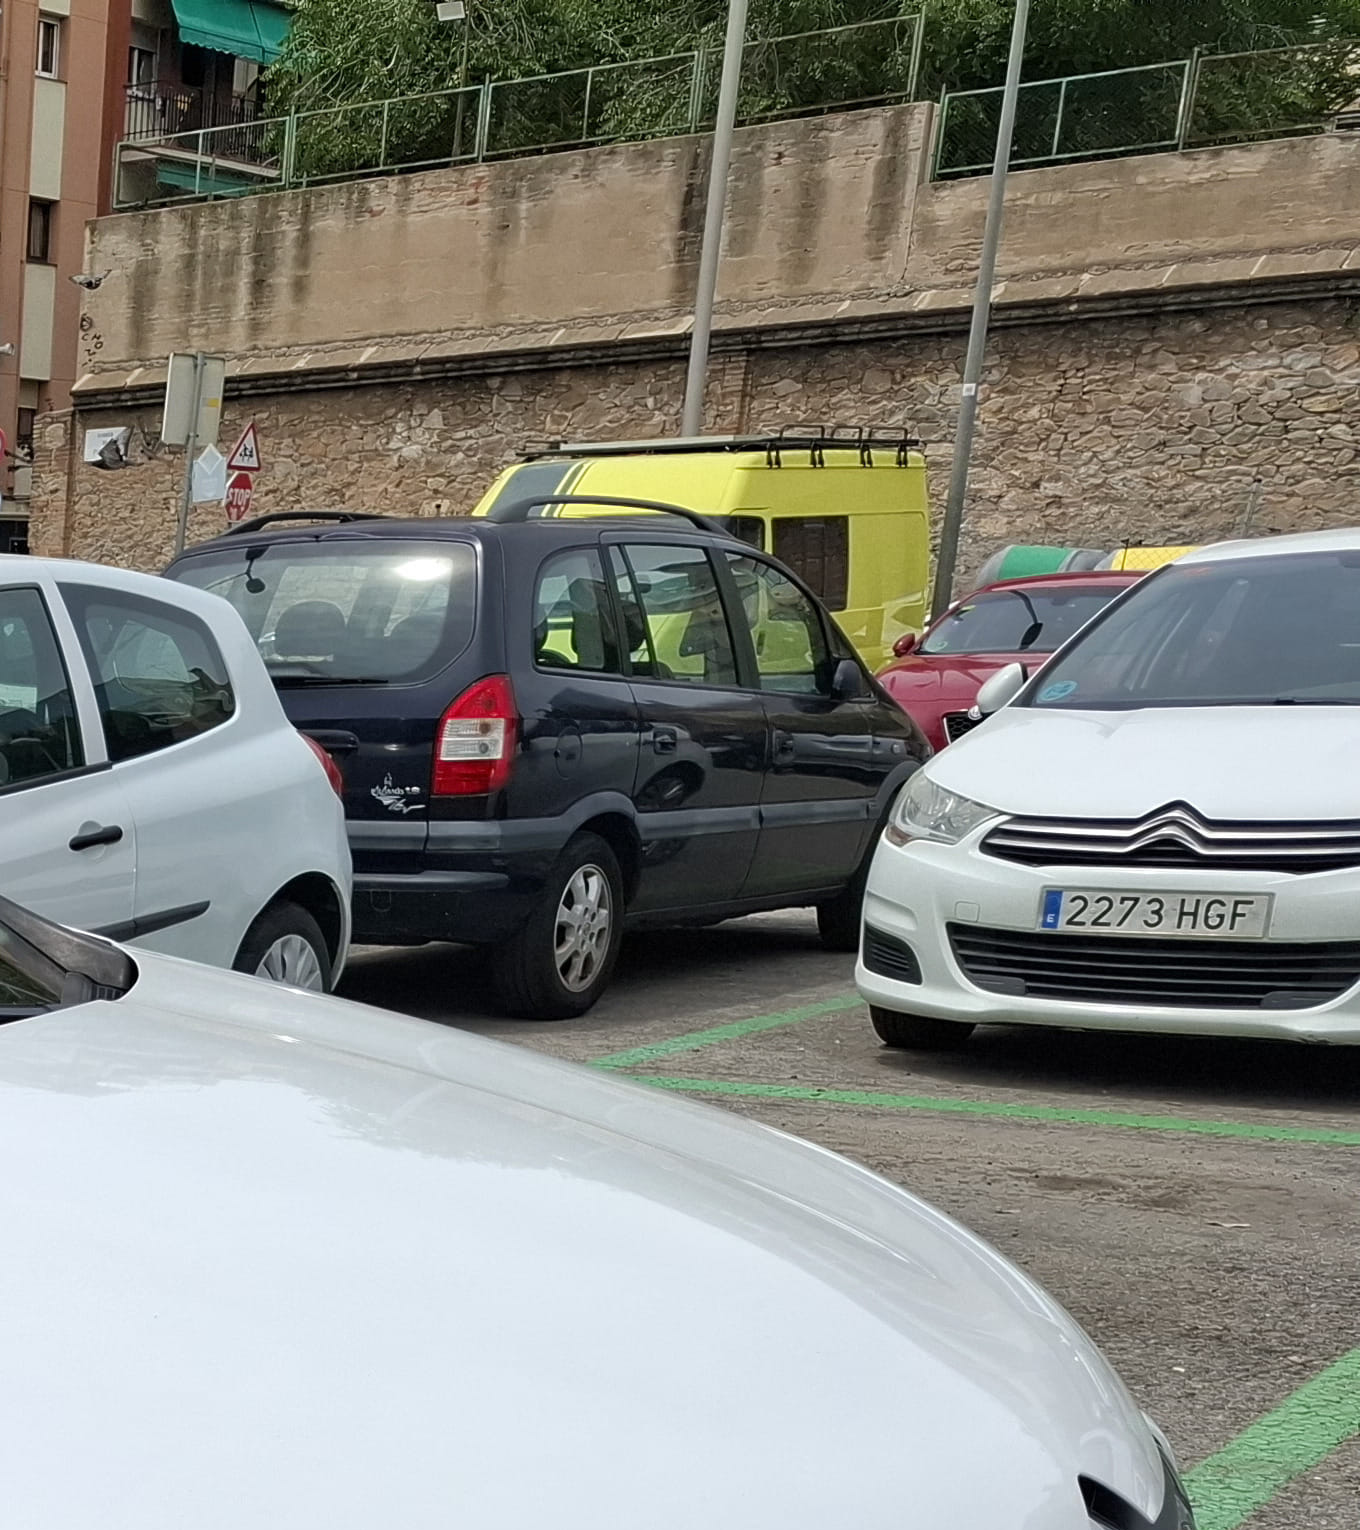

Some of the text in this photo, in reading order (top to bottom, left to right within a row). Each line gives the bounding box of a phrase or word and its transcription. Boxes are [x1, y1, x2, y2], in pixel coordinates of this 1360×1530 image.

[228, 488, 251, 506] STOP
[1065, 894, 1255, 931] 2273 HGF
